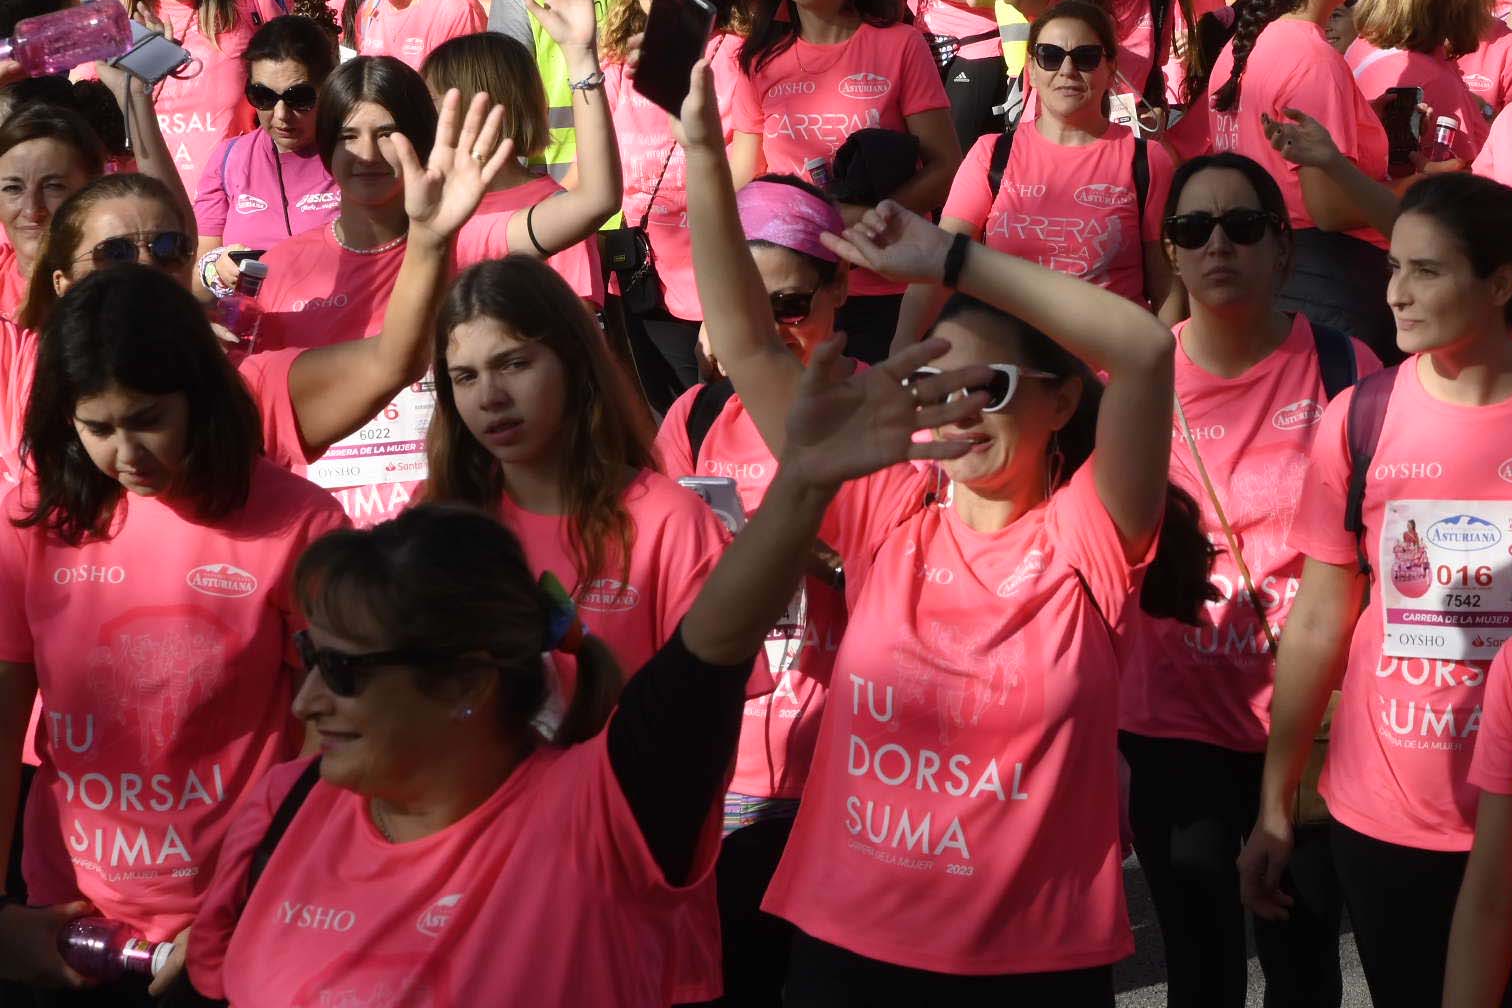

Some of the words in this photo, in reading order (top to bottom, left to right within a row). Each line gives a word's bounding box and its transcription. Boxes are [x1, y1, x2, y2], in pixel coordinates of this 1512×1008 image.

[767, 80, 816, 99] OYSHO
[359, 428, 391, 441] 6022
[360, 445, 372, 456] DE
[373, 445, 384, 455] LA
[386, 443, 416, 453] MUJER
[703, 459, 764, 480] OYSHO
[1375, 462, 1443, 481] OYSHO
[1432, 527, 1496, 543] ASTURIANA
[53, 565, 126, 586] OYSHO
[192, 576, 254, 592] ASTURIANA
[1436, 564, 1494, 587] 016
[1445, 594, 1481, 608] 7542
[1402, 612, 1444, 623] CARRERA
[1445, 614, 1459, 624] DE
[1460, 615, 1472, 624] LA
[1474, 615, 1510, 624] MUJER
[1399, 633, 1445, 648] OYSHO
[849, 673, 894, 725] TU
[49, 710, 94, 754] TU
[848, 735, 1029, 801] DORSAL
[846, 794, 971, 860] SUMA
[171, 866, 199, 878] 2023
[946, 863, 975, 877] 2023
